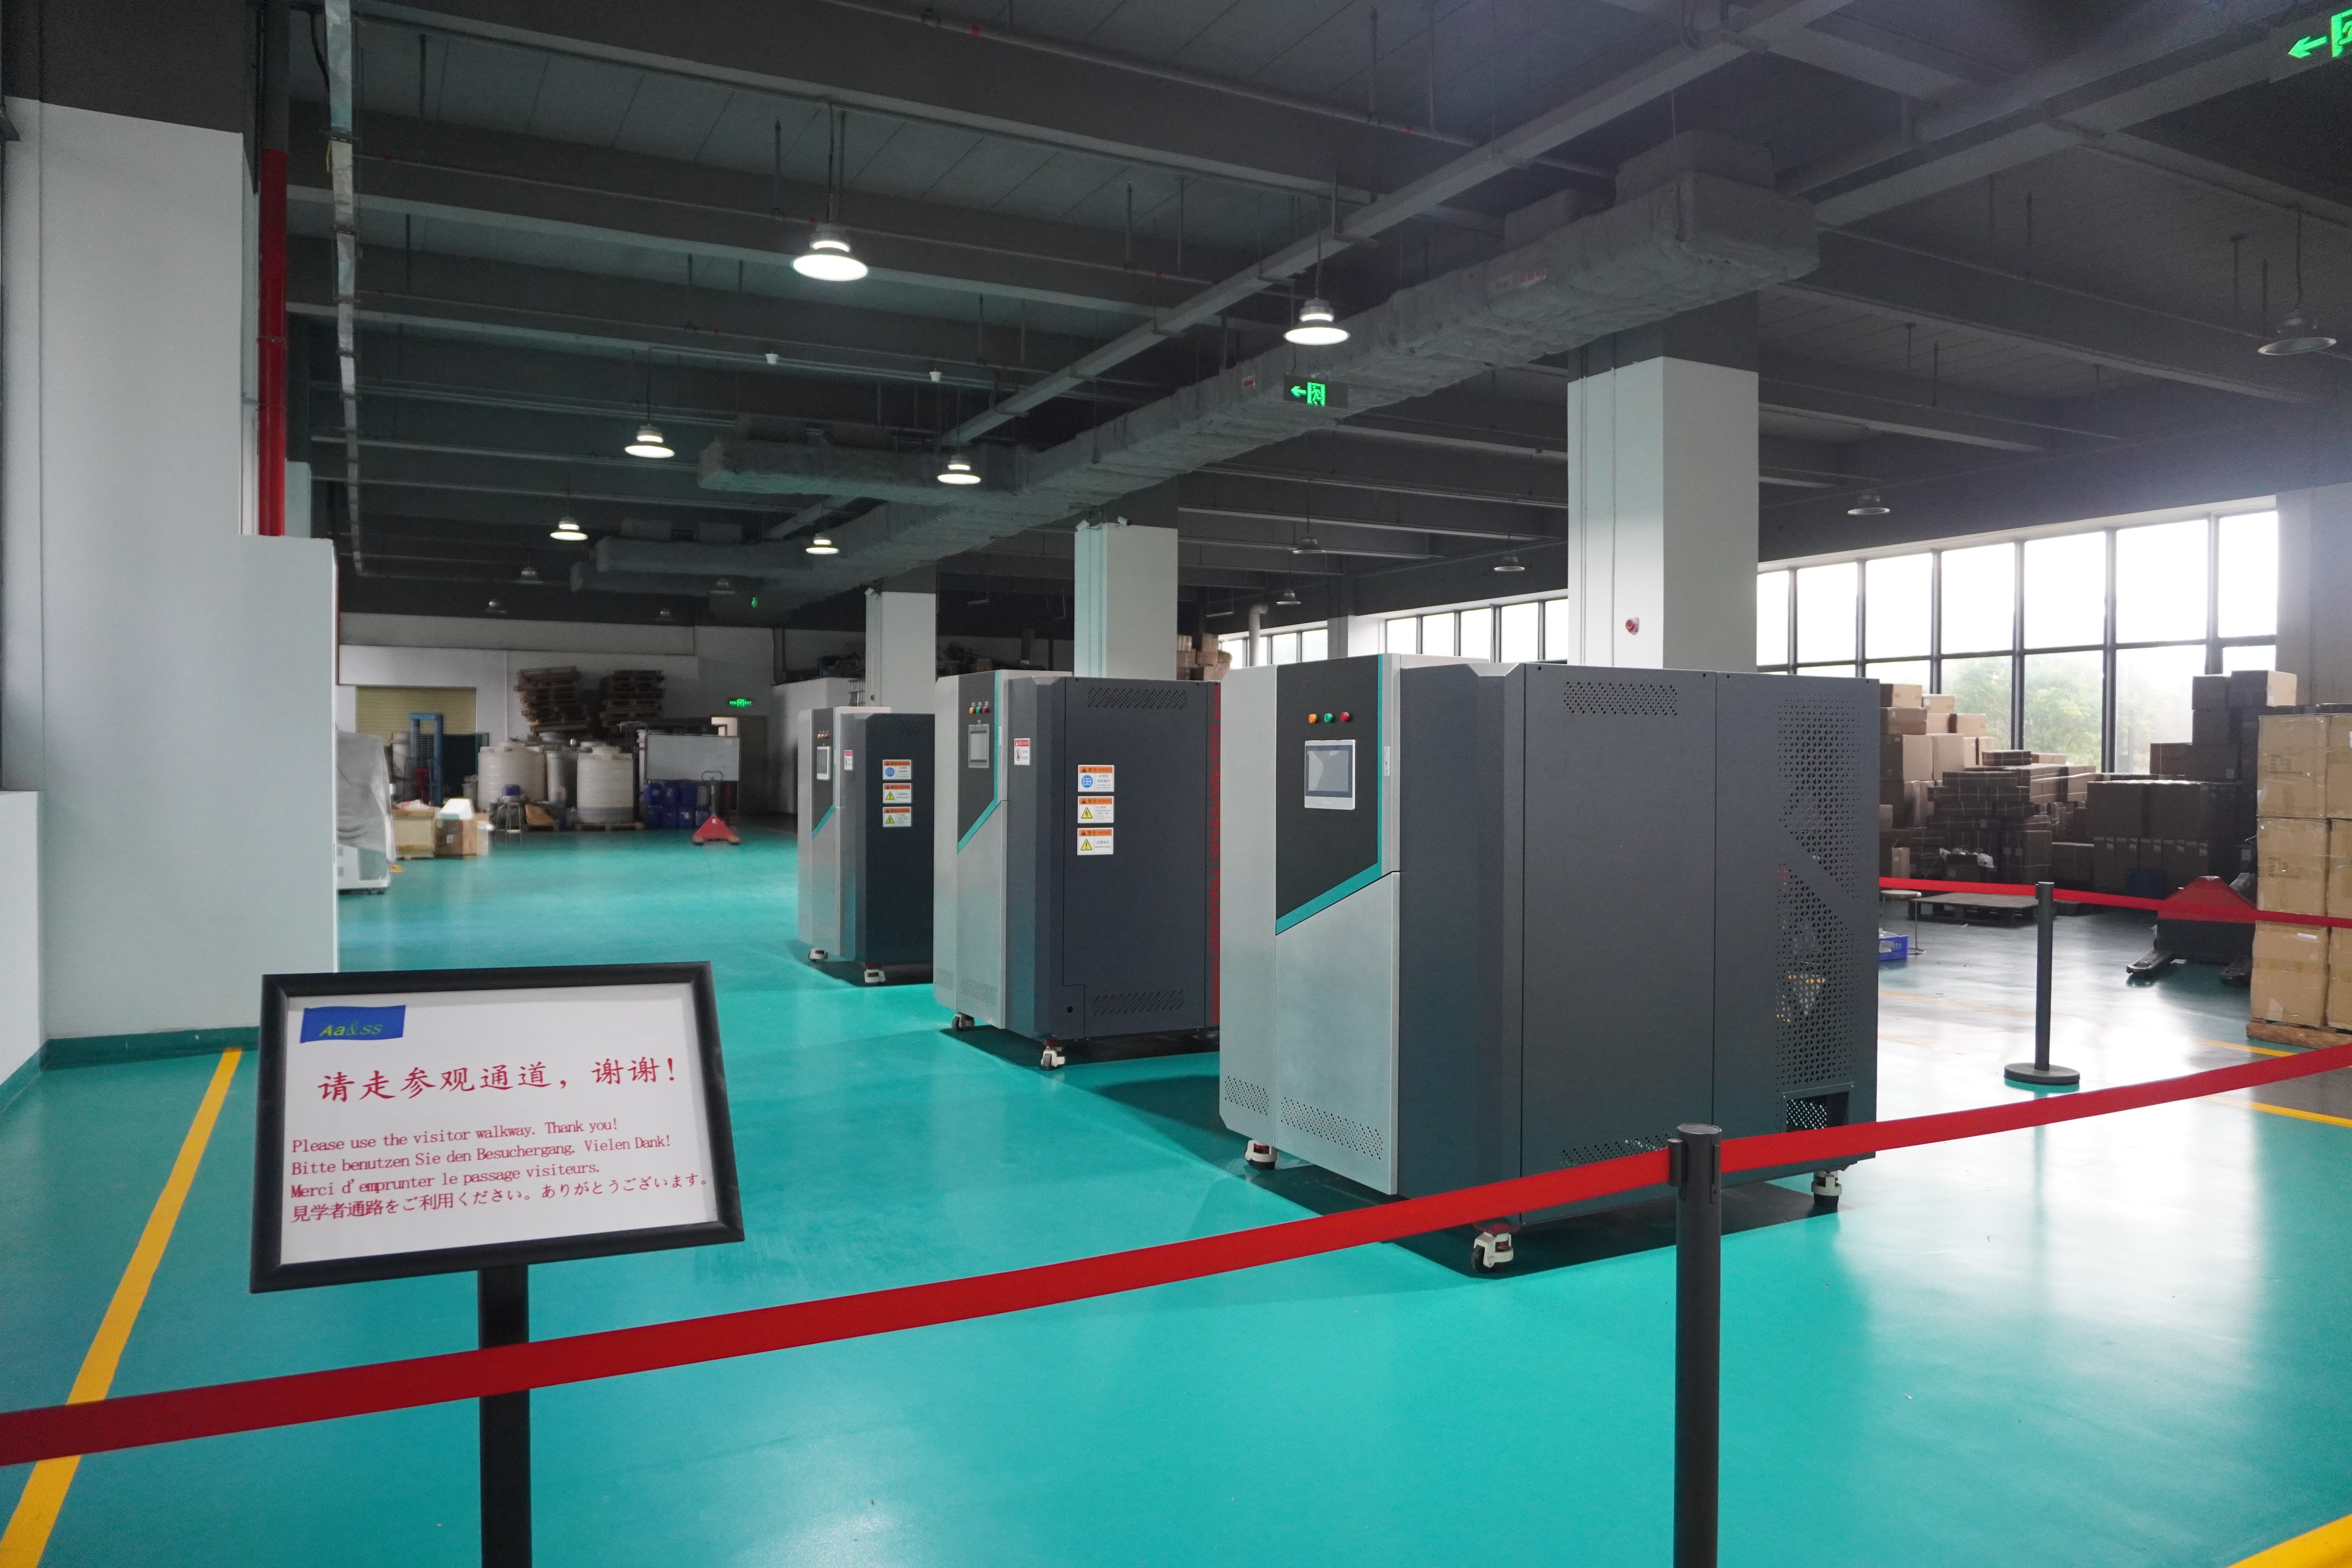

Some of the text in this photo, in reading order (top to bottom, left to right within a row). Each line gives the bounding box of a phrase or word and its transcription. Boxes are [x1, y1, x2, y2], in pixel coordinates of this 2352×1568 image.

[291, 1118, 617, 1154] Please use the visitor walkway. Thank you!
[291, 1134, 670, 1176] Bitte benutzen Sie den Besuchergang. Vielen Dank!
[290, 1184, 333, 1199] Merci
[443, 1172, 459, 1186] le
[463, 1170, 521, 1186] passage
[526, 1163, 600, 1178] visiteurs.
